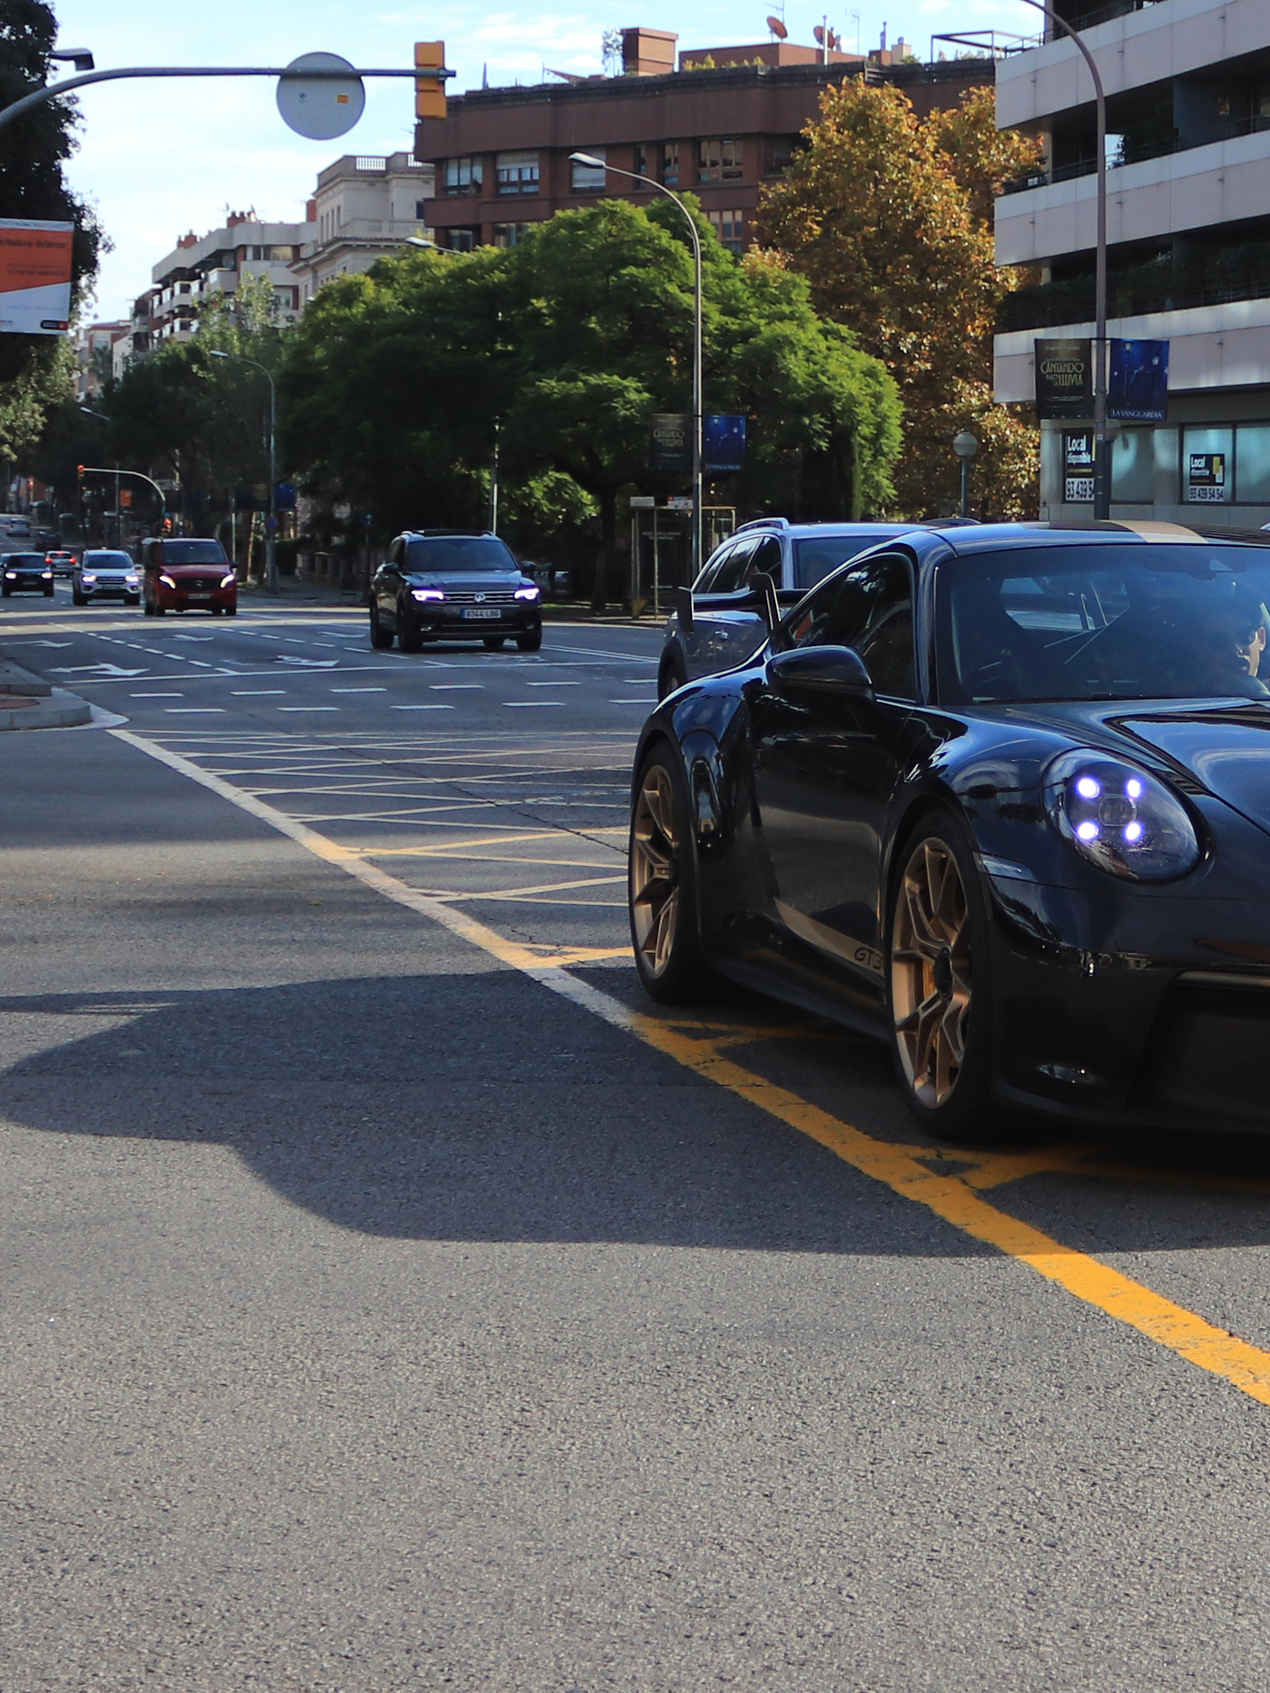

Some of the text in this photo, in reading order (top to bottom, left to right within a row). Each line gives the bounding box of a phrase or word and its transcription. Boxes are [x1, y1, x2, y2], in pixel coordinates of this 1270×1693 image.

[1041, 361, 1084, 374] CANTANDO
[1058, 374, 1083, 386] LLUVIA
[1121, 410, 1162, 418] VANGUARDIA
[1067, 435, 1086, 451] Local
[1191, 457, 1205, 467] Local
[1067, 480, 1074, 498] 93
[1076, 480, 1087, 498] 439
[854, 946, 881, 970] GT3
